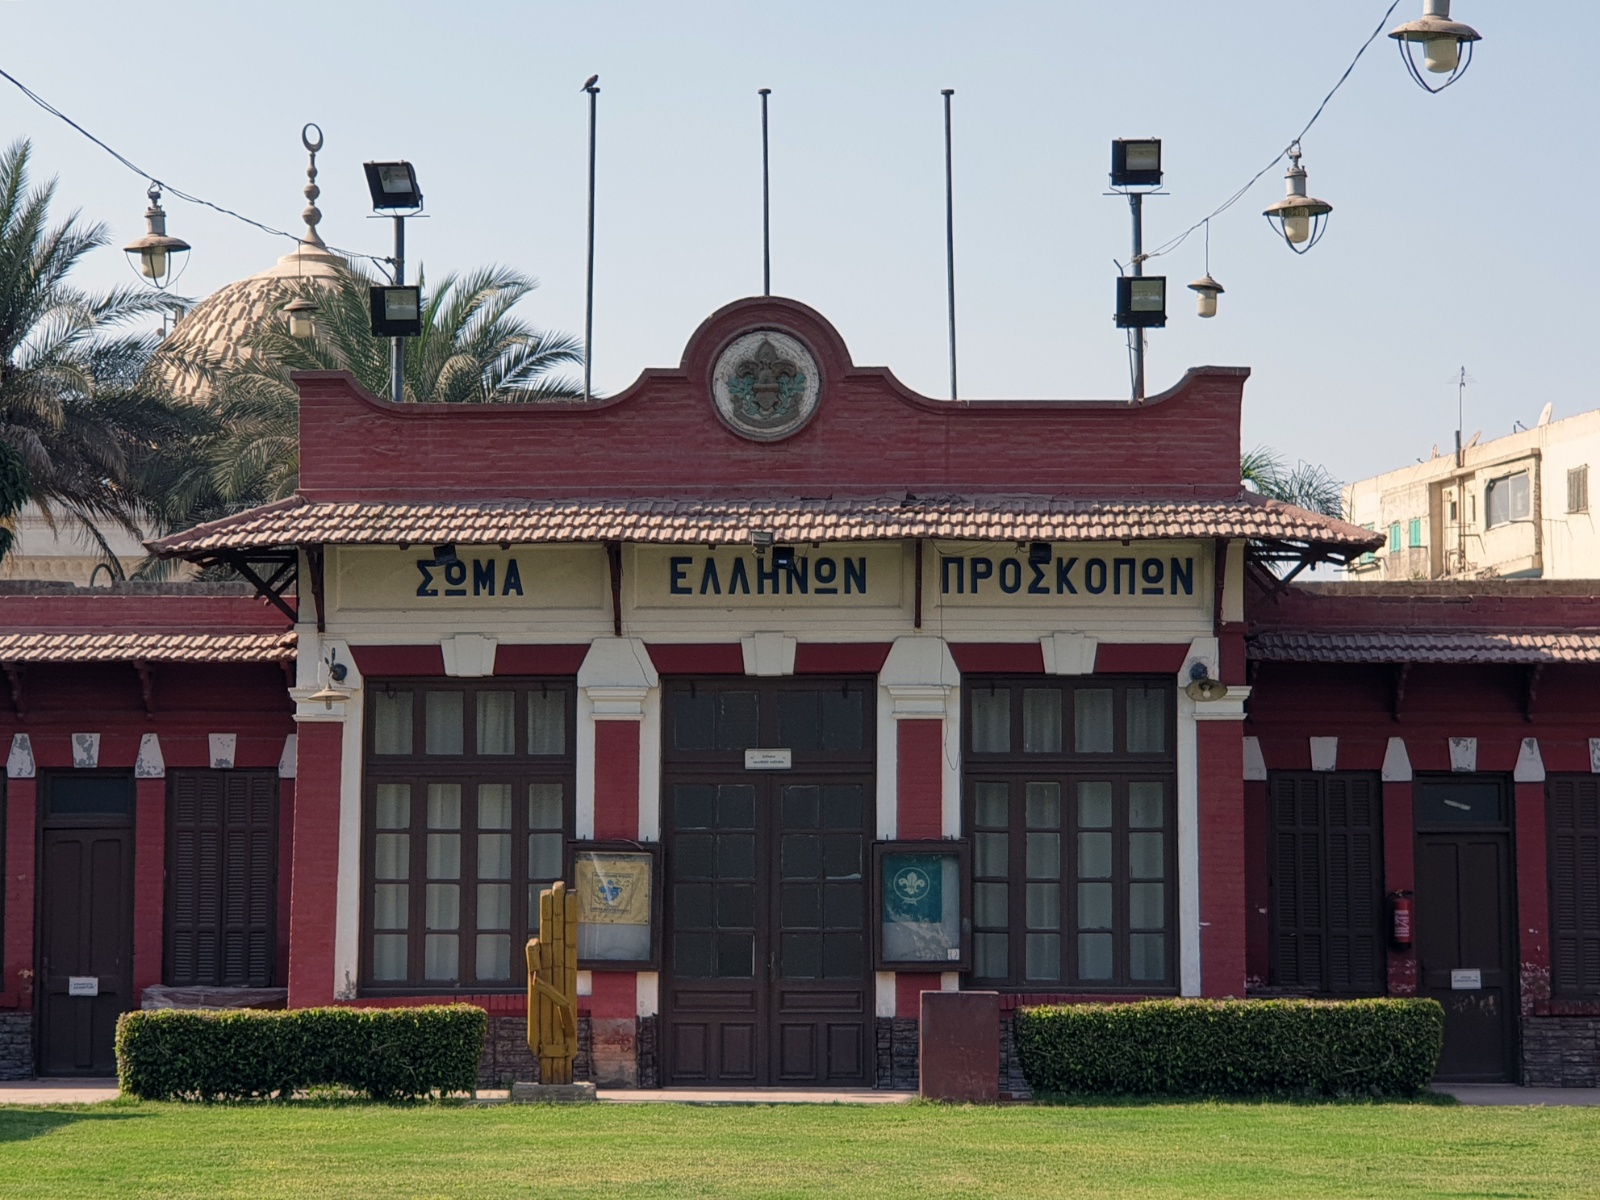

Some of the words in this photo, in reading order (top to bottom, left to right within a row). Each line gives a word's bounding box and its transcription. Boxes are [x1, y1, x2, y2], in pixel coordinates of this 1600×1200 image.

[416, 559, 524, 597] ΣΩΜΑ
[669, 556, 867, 595] ΕΛΛΗΝΩΝ
[941, 556, 1194, 595] ΠΡΟΣΚΟΠΩΝ
